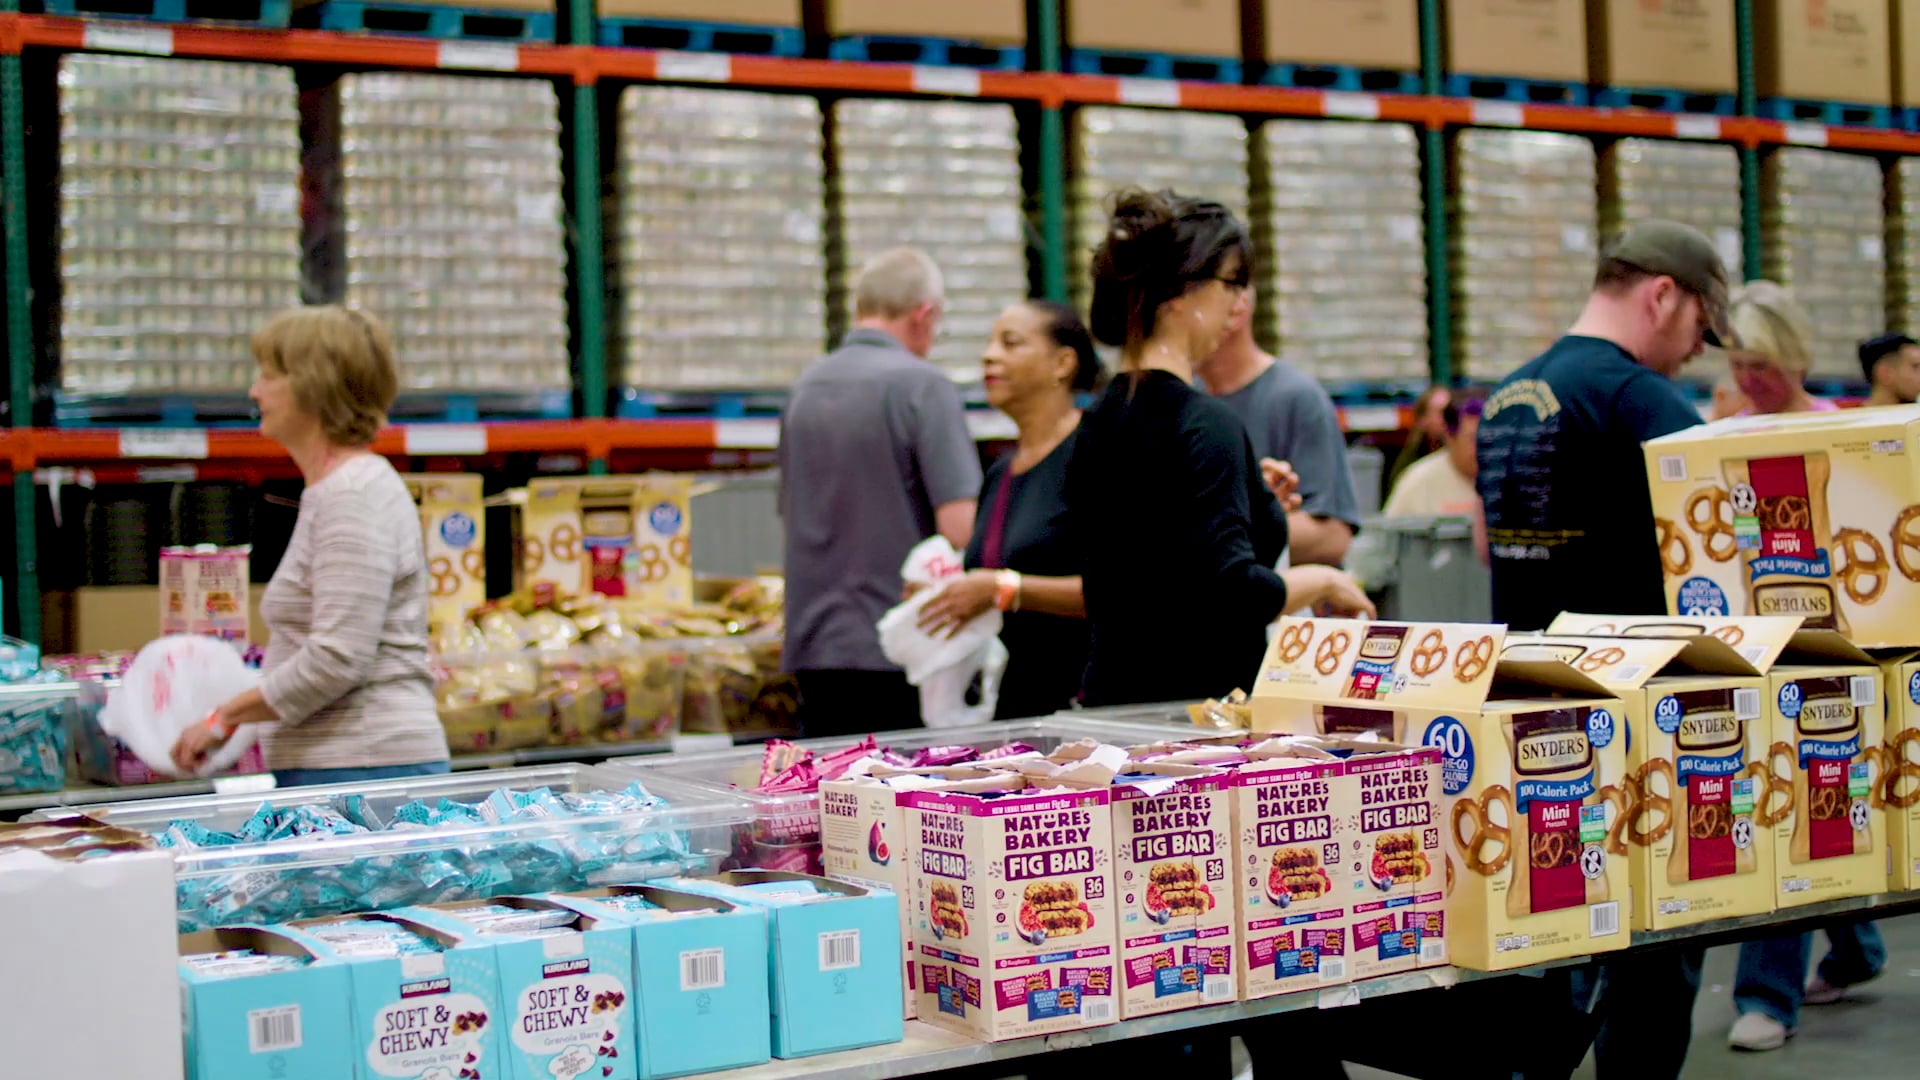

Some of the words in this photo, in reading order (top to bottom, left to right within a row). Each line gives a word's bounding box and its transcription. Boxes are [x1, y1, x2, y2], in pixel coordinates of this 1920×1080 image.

[1772, 538, 1800, 554] Mini
[1754, 559, 1775, 571] Pack
[1781, 684, 1799, 702] 60
[1659, 698, 1678, 716] 60
[1803, 702, 1852, 721] SNYDER'S
[1589, 711, 1610, 730] 60
[1682, 717, 1735, 736] SNYDER'S
[1429, 722, 1466, 758] 60
[1522, 737, 1584, 760] SNYDER'S
[1840, 742, 1857, 755] Pack
[1681, 759, 1693, 771] 100
[1694, 760, 1722, 772] Calorie
[1723, 758, 1740, 771] Pack
[1819, 762, 1841, 777] Mini
[1361, 783, 1428, 805] BAKERY
[1520, 785, 1534, 797] 100
[1536, 784, 1567, 797] Calorie
[1569, 781, 1590, 796] Pack
[1699, 778, 1723, 794] Mini
[825, 803, 858, 818] BAKERY
[1257, 796, 1329, 819] BAKERY
[1542, 804, 1570, 821] Mini
[1133, 811, 1211, 833] BAKERY
[1364, 808, 1391, 831] FIG
[1395, 804, 1428, 826] BAR
[921, 829, 964, 850] BAKERY
[1005, 827, 1091, 851] BAKERY
[1260, 823, 1290, 844] FIG
[1294, 817, 1329, 840] BAR
[1424, 830, 1438, 844] 36
[1136, 836, 1168, 860] FIG
[1171, 833, 1211, 855] BAR
[1324, 845, 1338, 860] 36
[923, 851, 941, 873] FIG
[942, 855, 965, 877] BAR
[1009, 854, 1045, 878] FIG
[1049, 849, 1090, 873] BAR
[1207, 860, 1223, 876] 36
[962, 886, 974, 903] 36
[1086, 878, 1103, 894] 36
[544, 960, 589, 974] KIRKLAND
[528, 986, 570, 1011] SOFT
[574, 984, 591, 1003] &
[386, 1006, 429, 1032] SOFT
[434, 1004, 451, 1023] &
[523, 1005, 589, 1034] CHEWY
[379, 1026, 450, 1055] CHEWY
[544, 1035, 577, 1046] Granola
[580, 1032, 599, 1040] Bars
[402, 1056, 437, 1068] Granola
[440, 1053, 460, 1062] Bars
